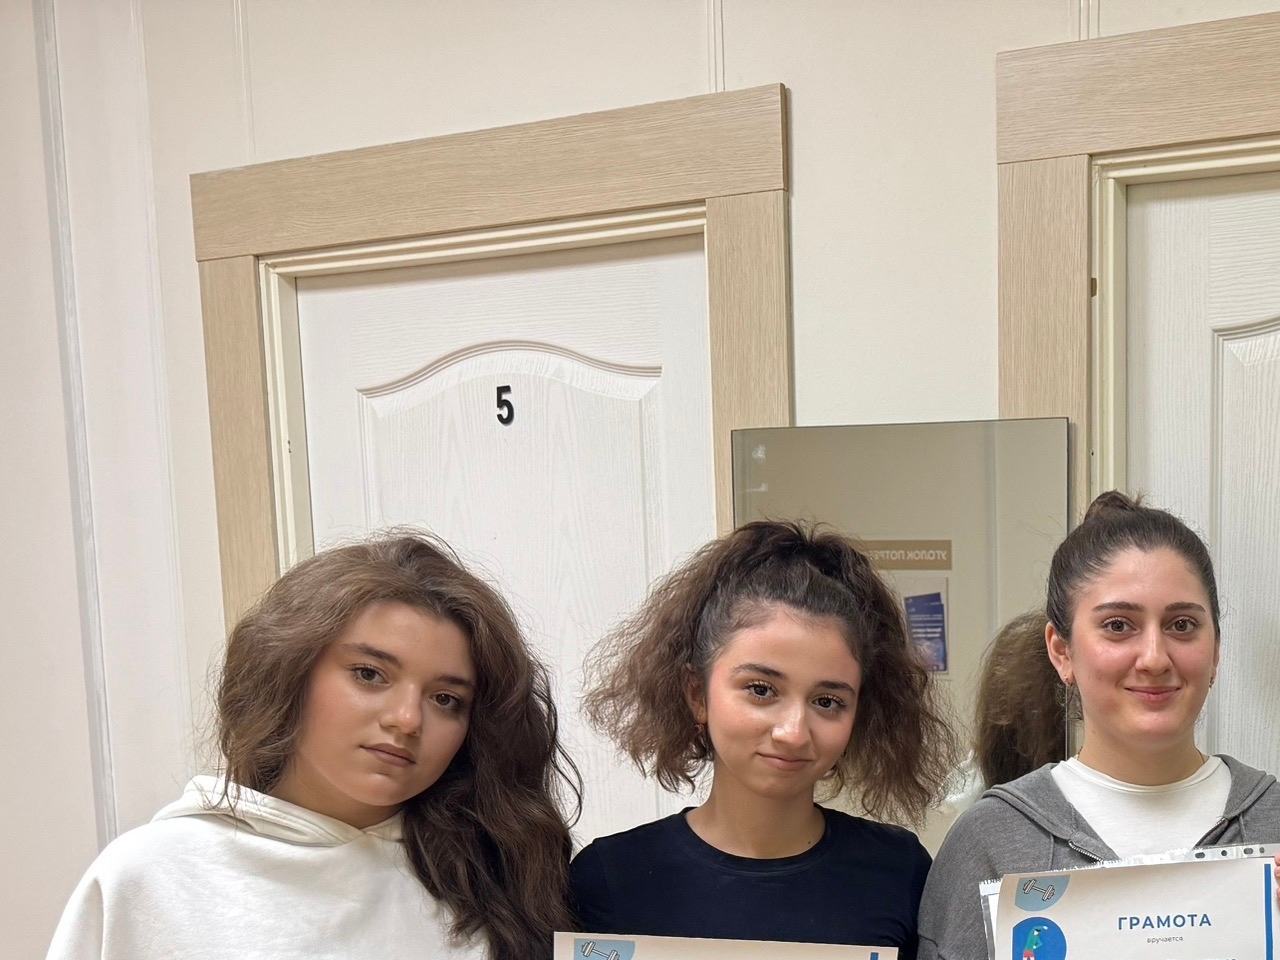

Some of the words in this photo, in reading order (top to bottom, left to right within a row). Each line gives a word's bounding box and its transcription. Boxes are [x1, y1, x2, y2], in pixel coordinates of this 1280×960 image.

[496, 385, 514, 426] 5
[1119, 914, 1211, 930] ГРАМОТА
[1147, 936, 1183, 944] вручается
